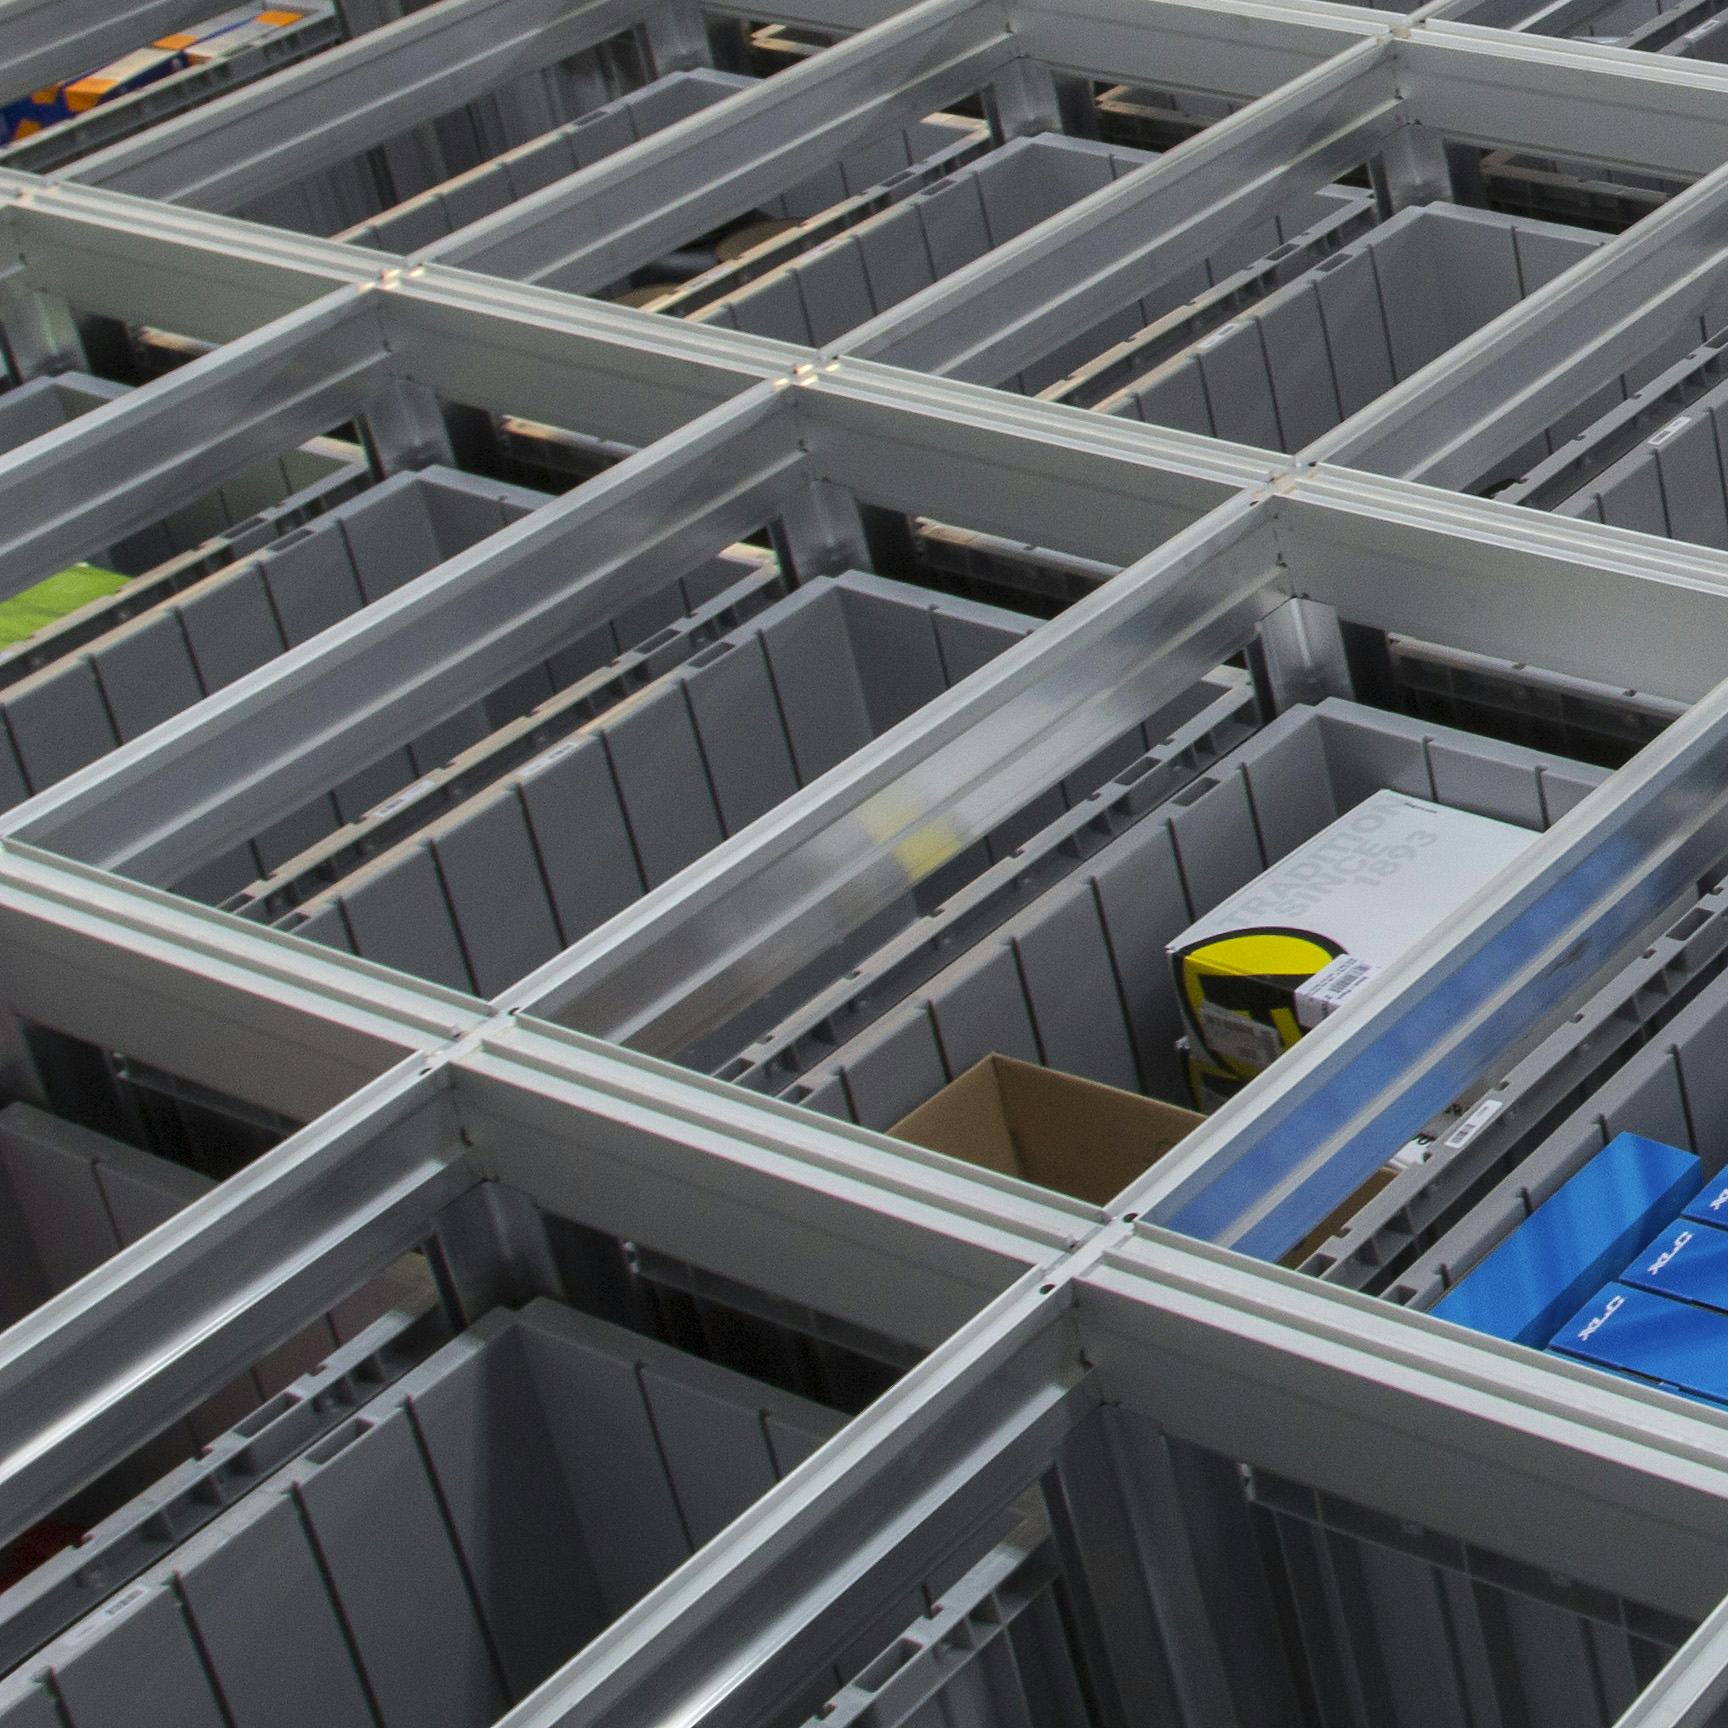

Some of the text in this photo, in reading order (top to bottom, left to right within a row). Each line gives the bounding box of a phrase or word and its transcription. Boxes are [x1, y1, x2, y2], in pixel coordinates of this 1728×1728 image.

[1274, 839, 1391, 918] SINCE
[1353, 830, 1438, 886] 1893
[1647, 1231, 1695, 1275] XLC
[1577, 1295, 1626, 1341] XLC
